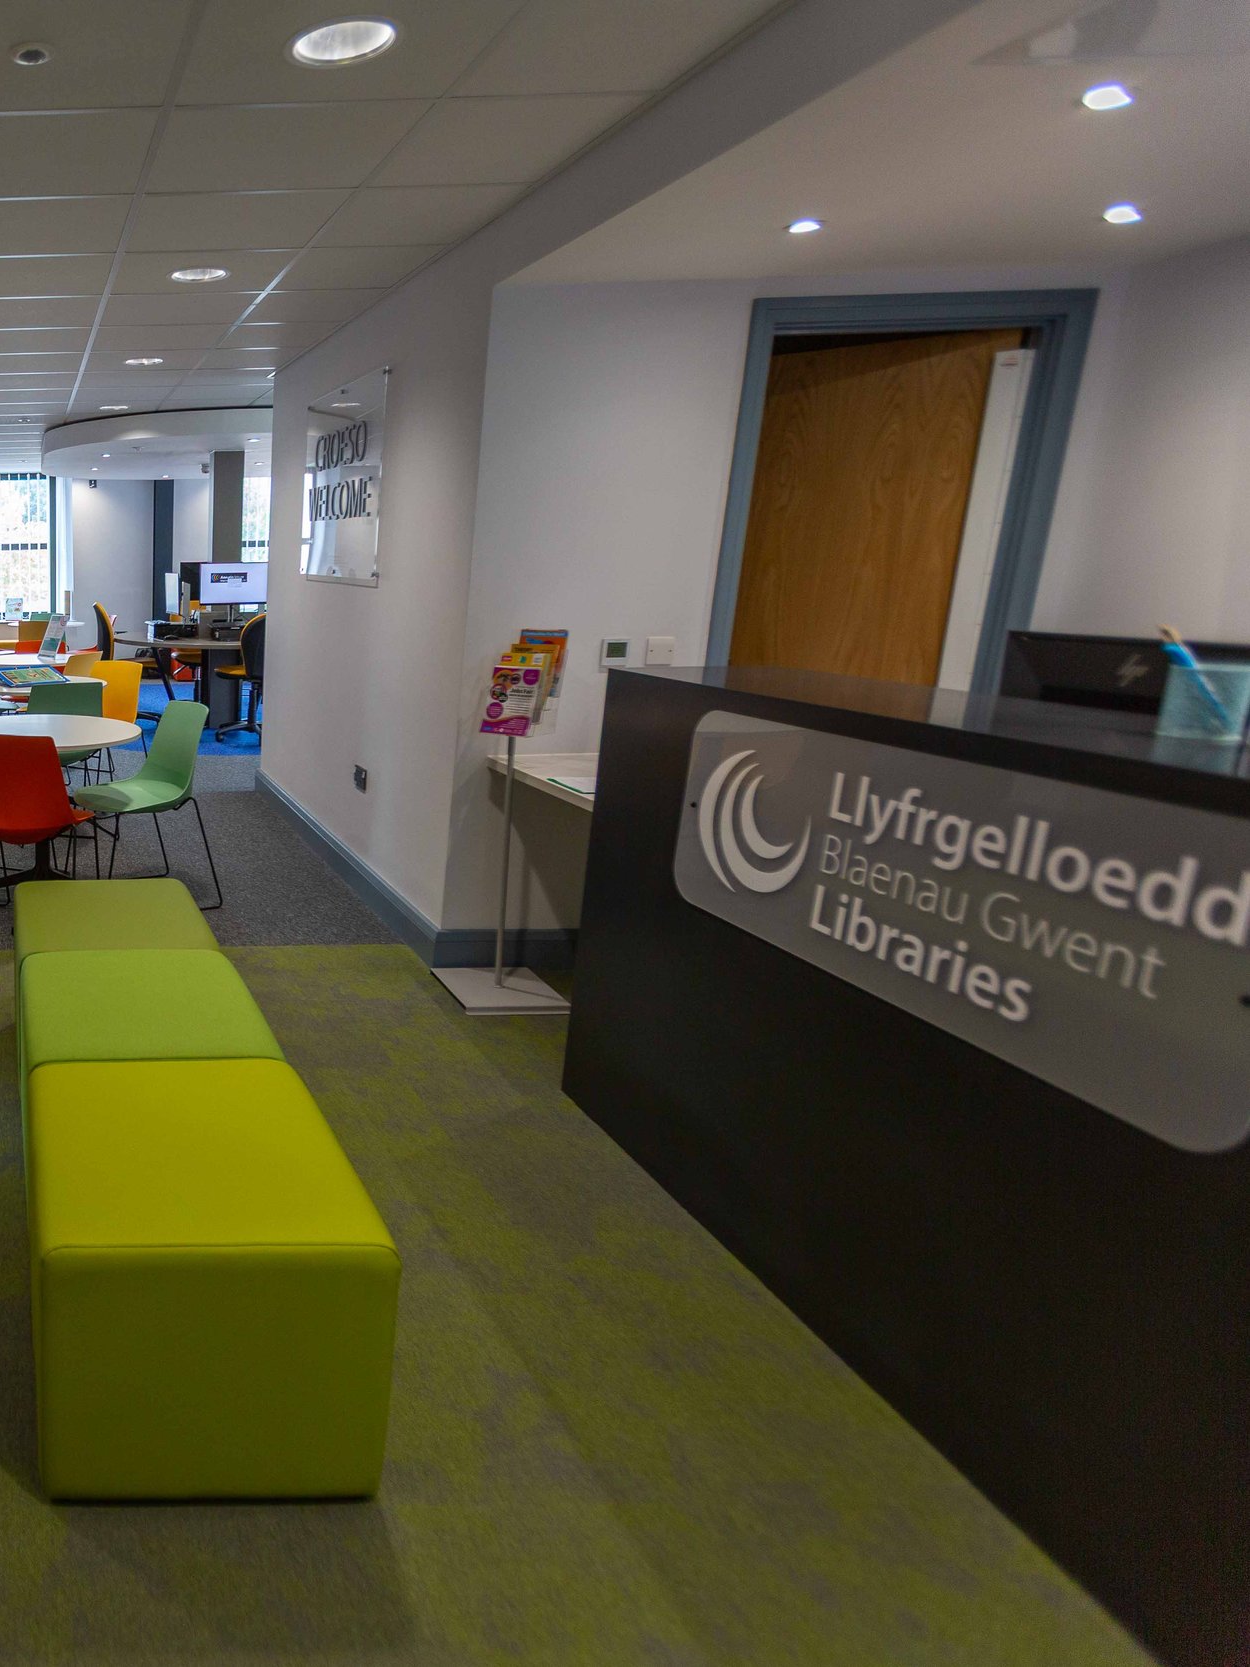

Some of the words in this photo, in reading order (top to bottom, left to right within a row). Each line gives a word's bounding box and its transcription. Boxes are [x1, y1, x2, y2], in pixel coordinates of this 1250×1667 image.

[308, 476, 373, 522] WELCOME
[316, 420, 368, 472] CROESO
[819, 833, 969, 925] Blaenau
[979, 891, 1167, 1000] Gwent
[828, 770, 1250, 949] Llyfrgelloedd
[808, 884, 1033, 1023] Libraries
